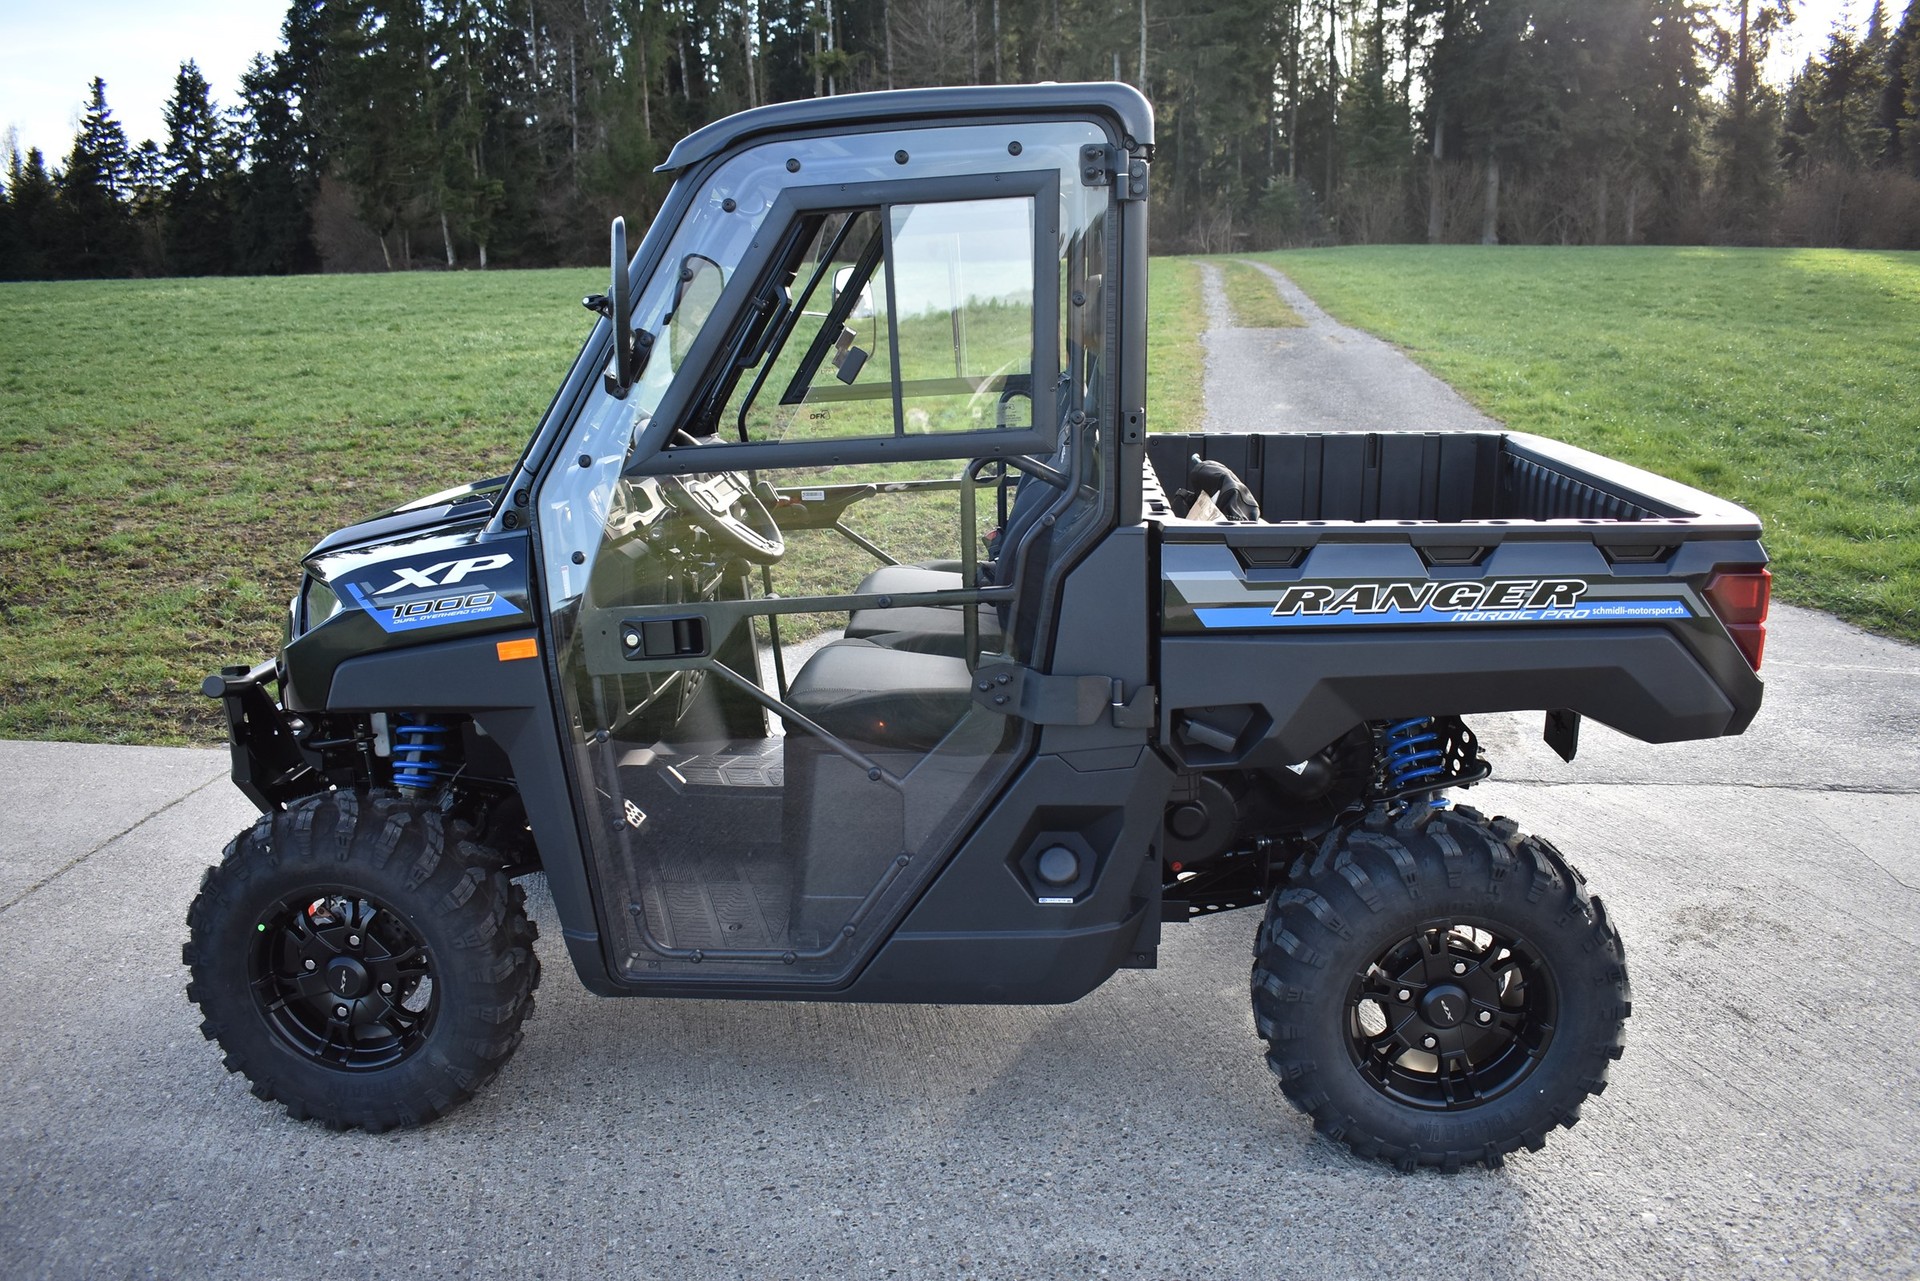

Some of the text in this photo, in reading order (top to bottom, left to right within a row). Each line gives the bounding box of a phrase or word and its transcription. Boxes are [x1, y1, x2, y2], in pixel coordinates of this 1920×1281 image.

[374, 553, 514, 595] XP
[392, 591, 497, 619] 1000
[1270, 578, 1588, 616] RANGER
[393, 606, 493, 625] DUAL OVERHEAD CAM
[1451, 609, 1591, 621] NORDIC PRO
[1592, 606, 1684, 616] schmidli-motorsport.ch
